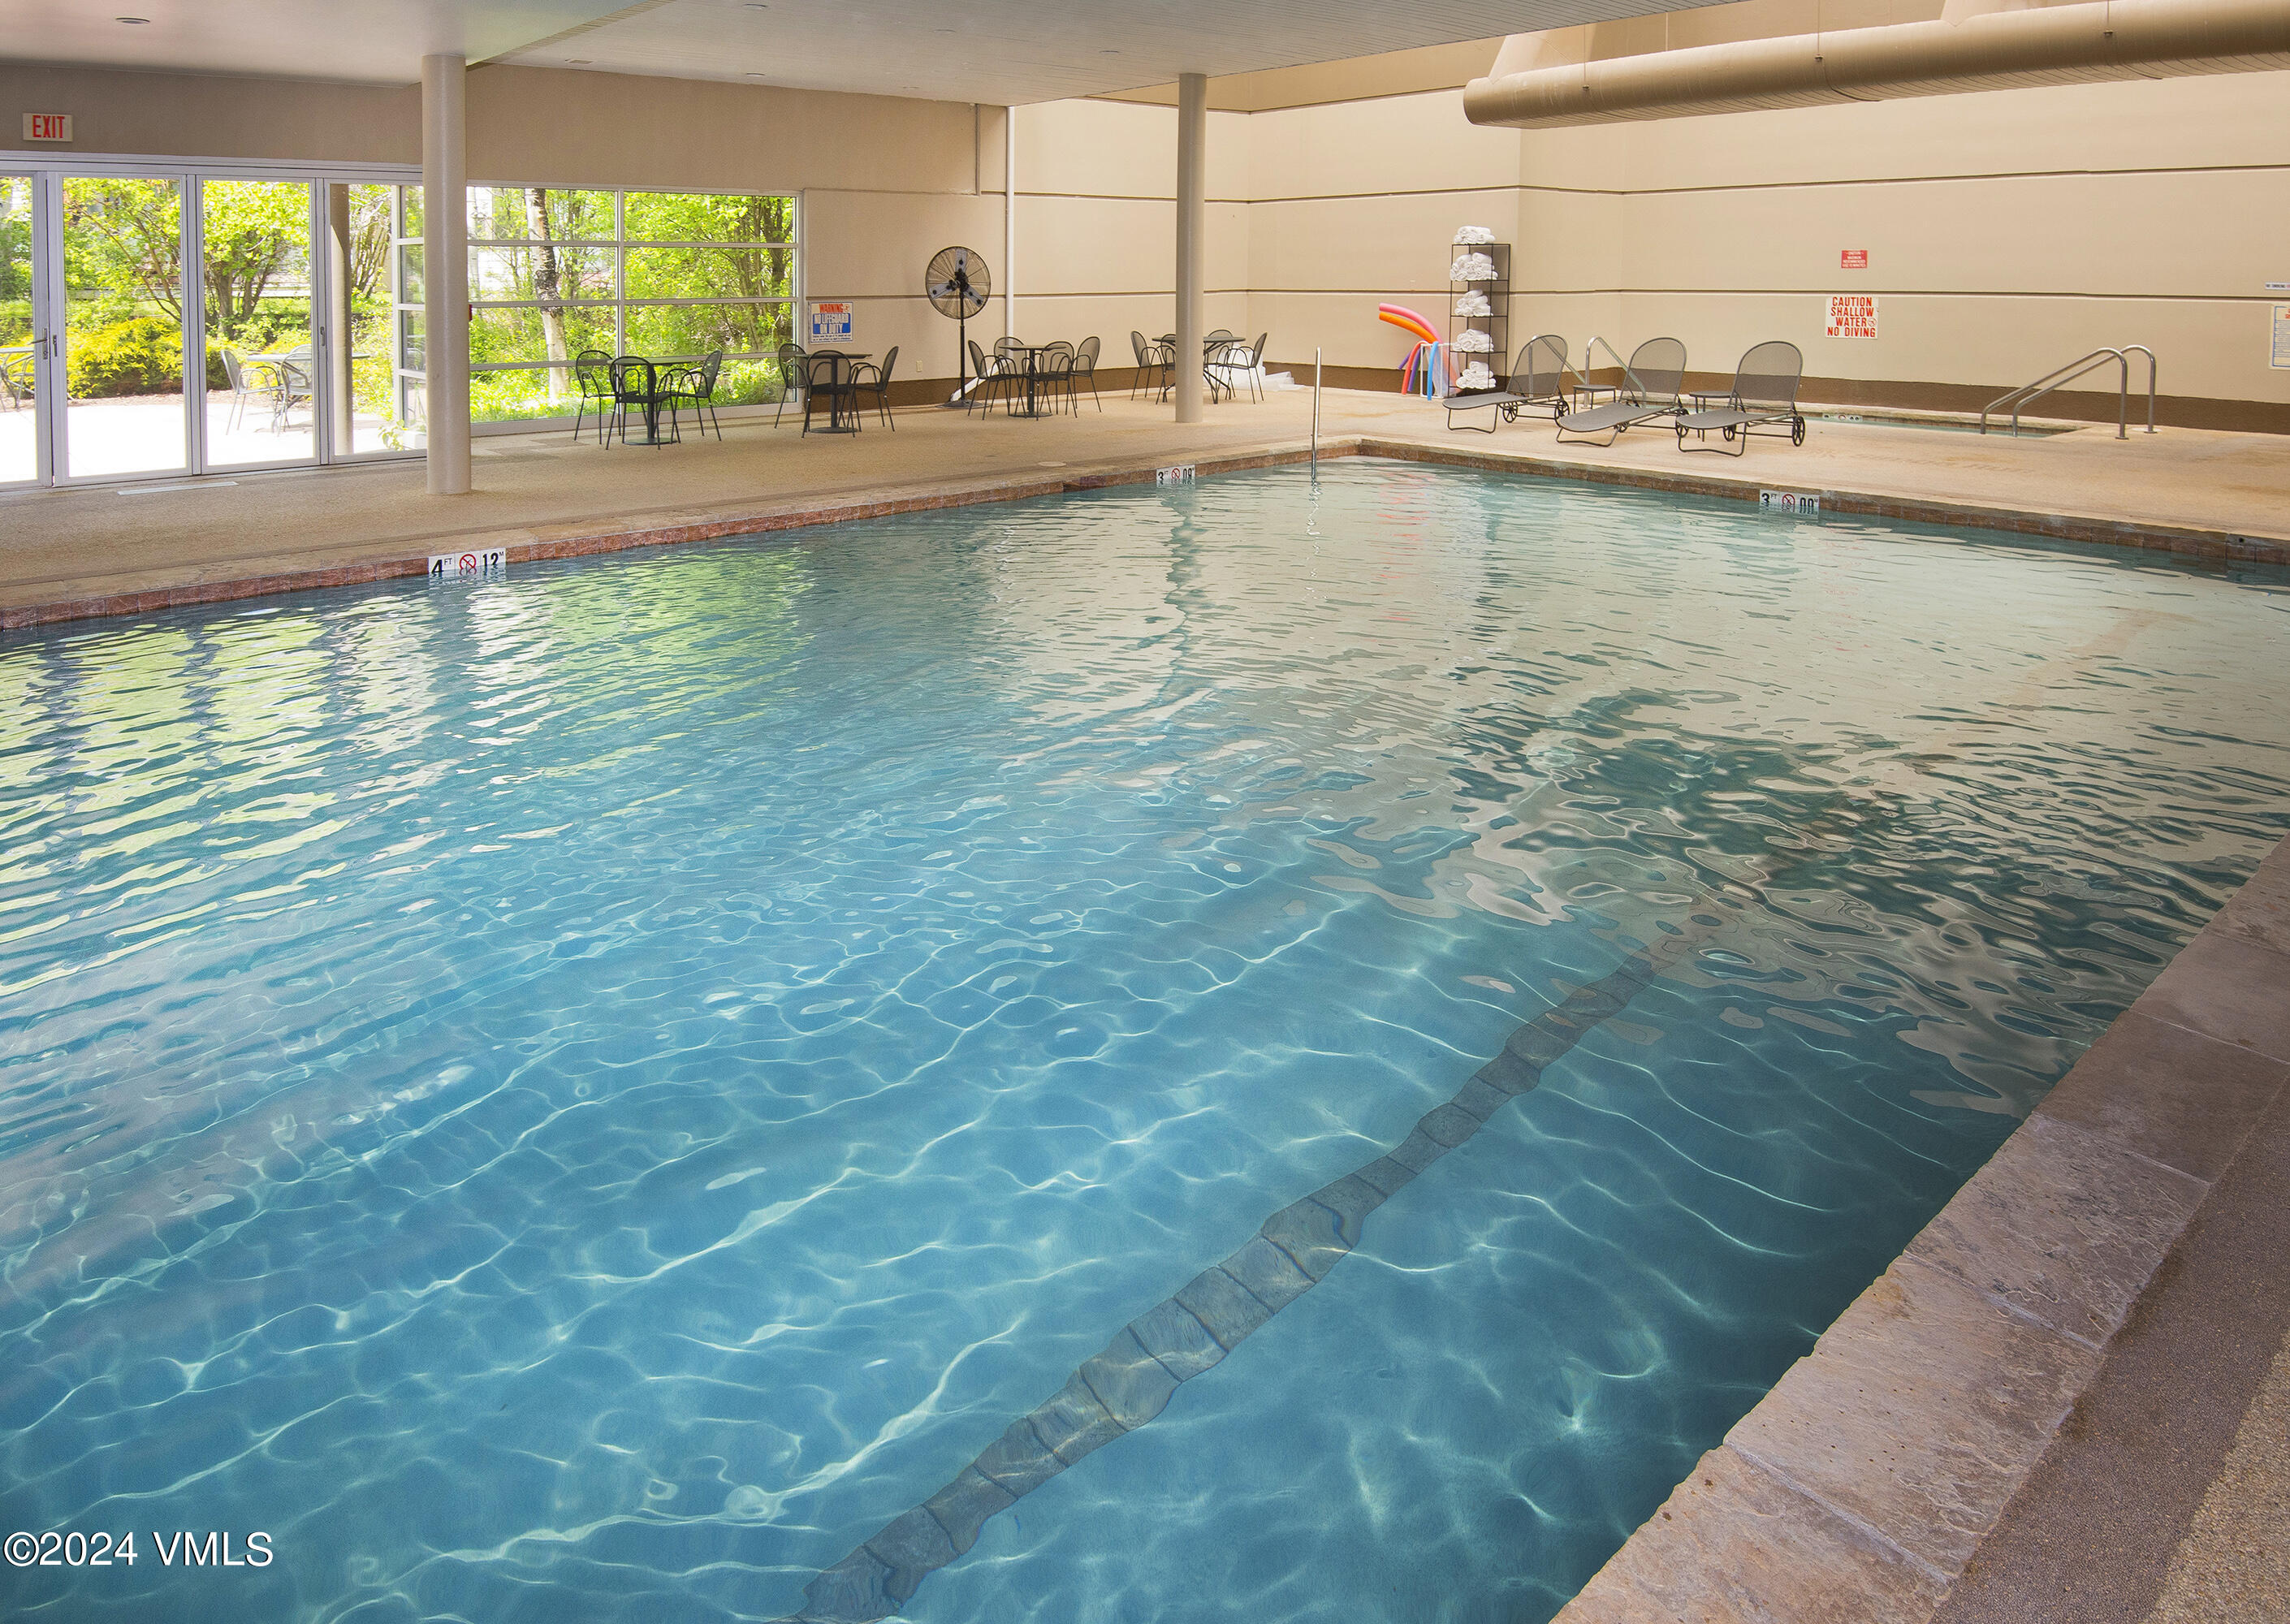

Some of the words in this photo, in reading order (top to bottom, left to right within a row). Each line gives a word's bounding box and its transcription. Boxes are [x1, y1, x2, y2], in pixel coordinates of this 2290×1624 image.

[32, 114, 65, 139] EXIT
[1832, 296, 1873, 307] CAUTION
[819, 303, 844, 313] WARNING
[1830, 307, 1874, 317] SHALLOW
[1835, 317, 1867, 327] WATER
[1827, 326, 1839, 336] NO
[1844, 327, 1876, 338] DIVING
[431, 559, 444, 573] 4
